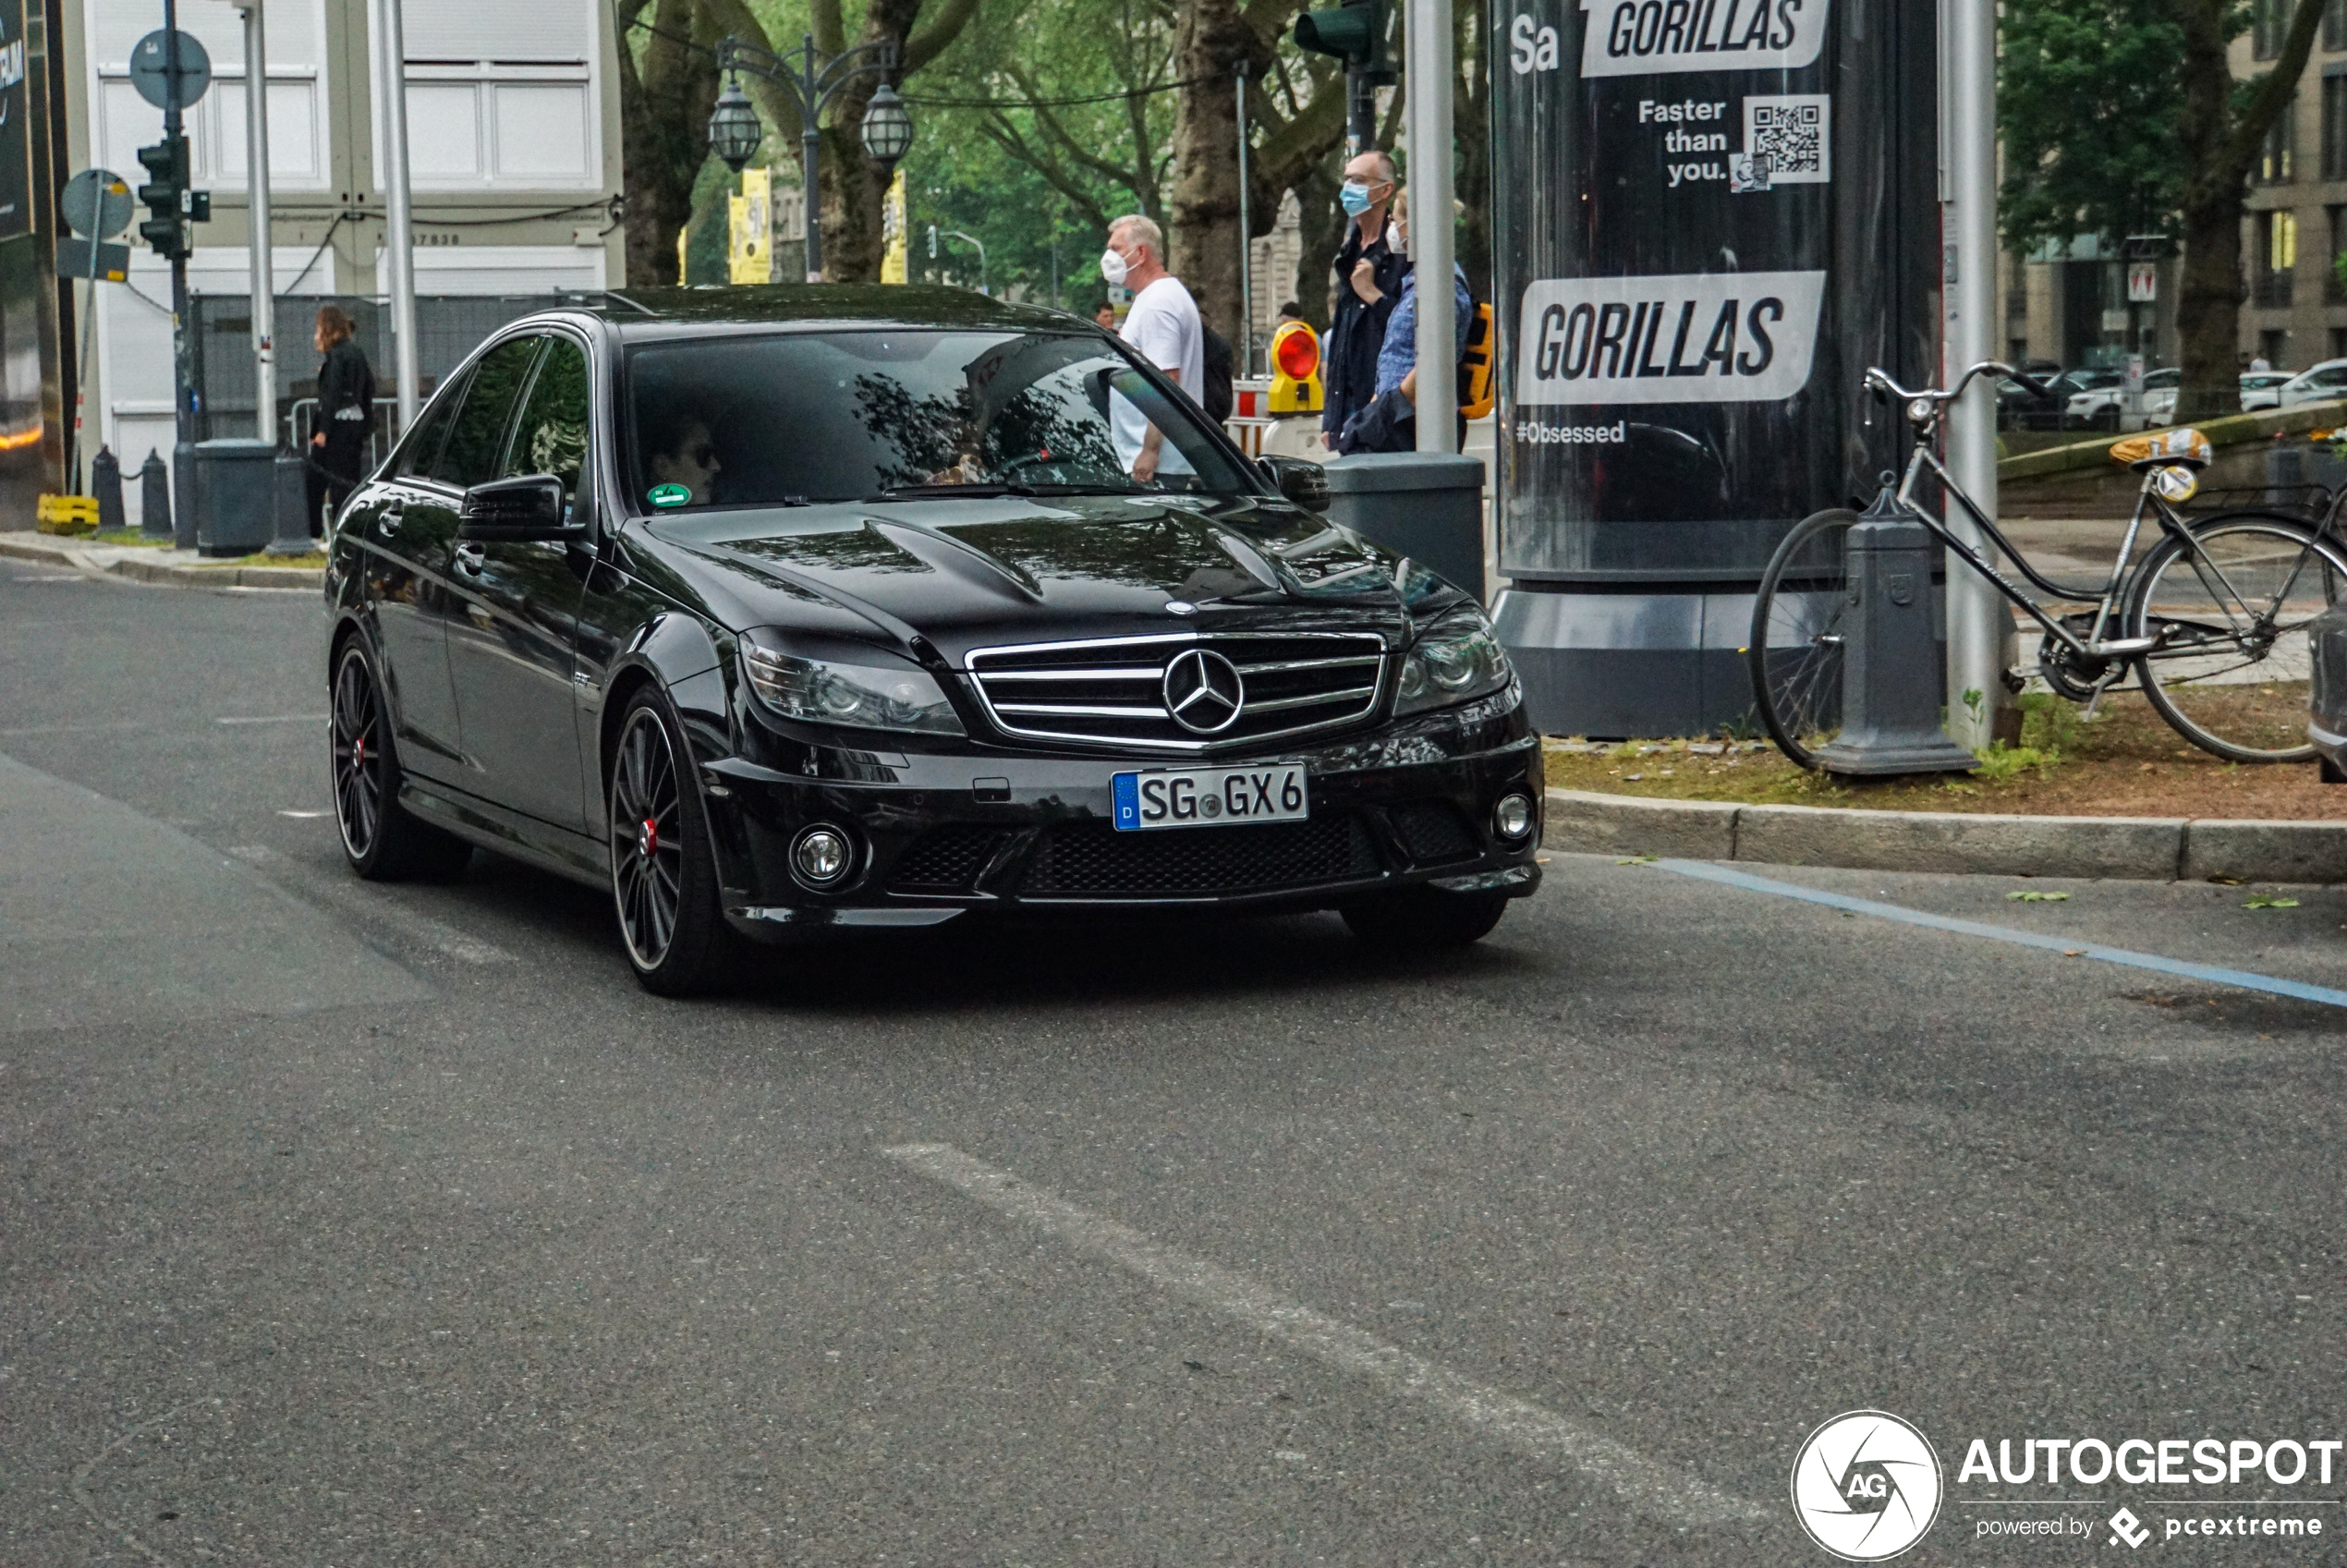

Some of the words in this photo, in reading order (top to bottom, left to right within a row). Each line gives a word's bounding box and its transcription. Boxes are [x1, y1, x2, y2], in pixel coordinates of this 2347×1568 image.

[1607, 0, 1803, 58] GORILLAS
[1510, 14, 1559, 75] Sa
[1638, 99, 1726, 123] Faster
[1664, 128, 1727, 154] than
[1667, 159, 1727, 188] you.
[1535, 297, 1784, 382] GORILLAS
[1515, 420, 1625, 444] #Obsessed
[1122, 807, 1133, 819] D
[1141, 777, 1198, 820] SG
